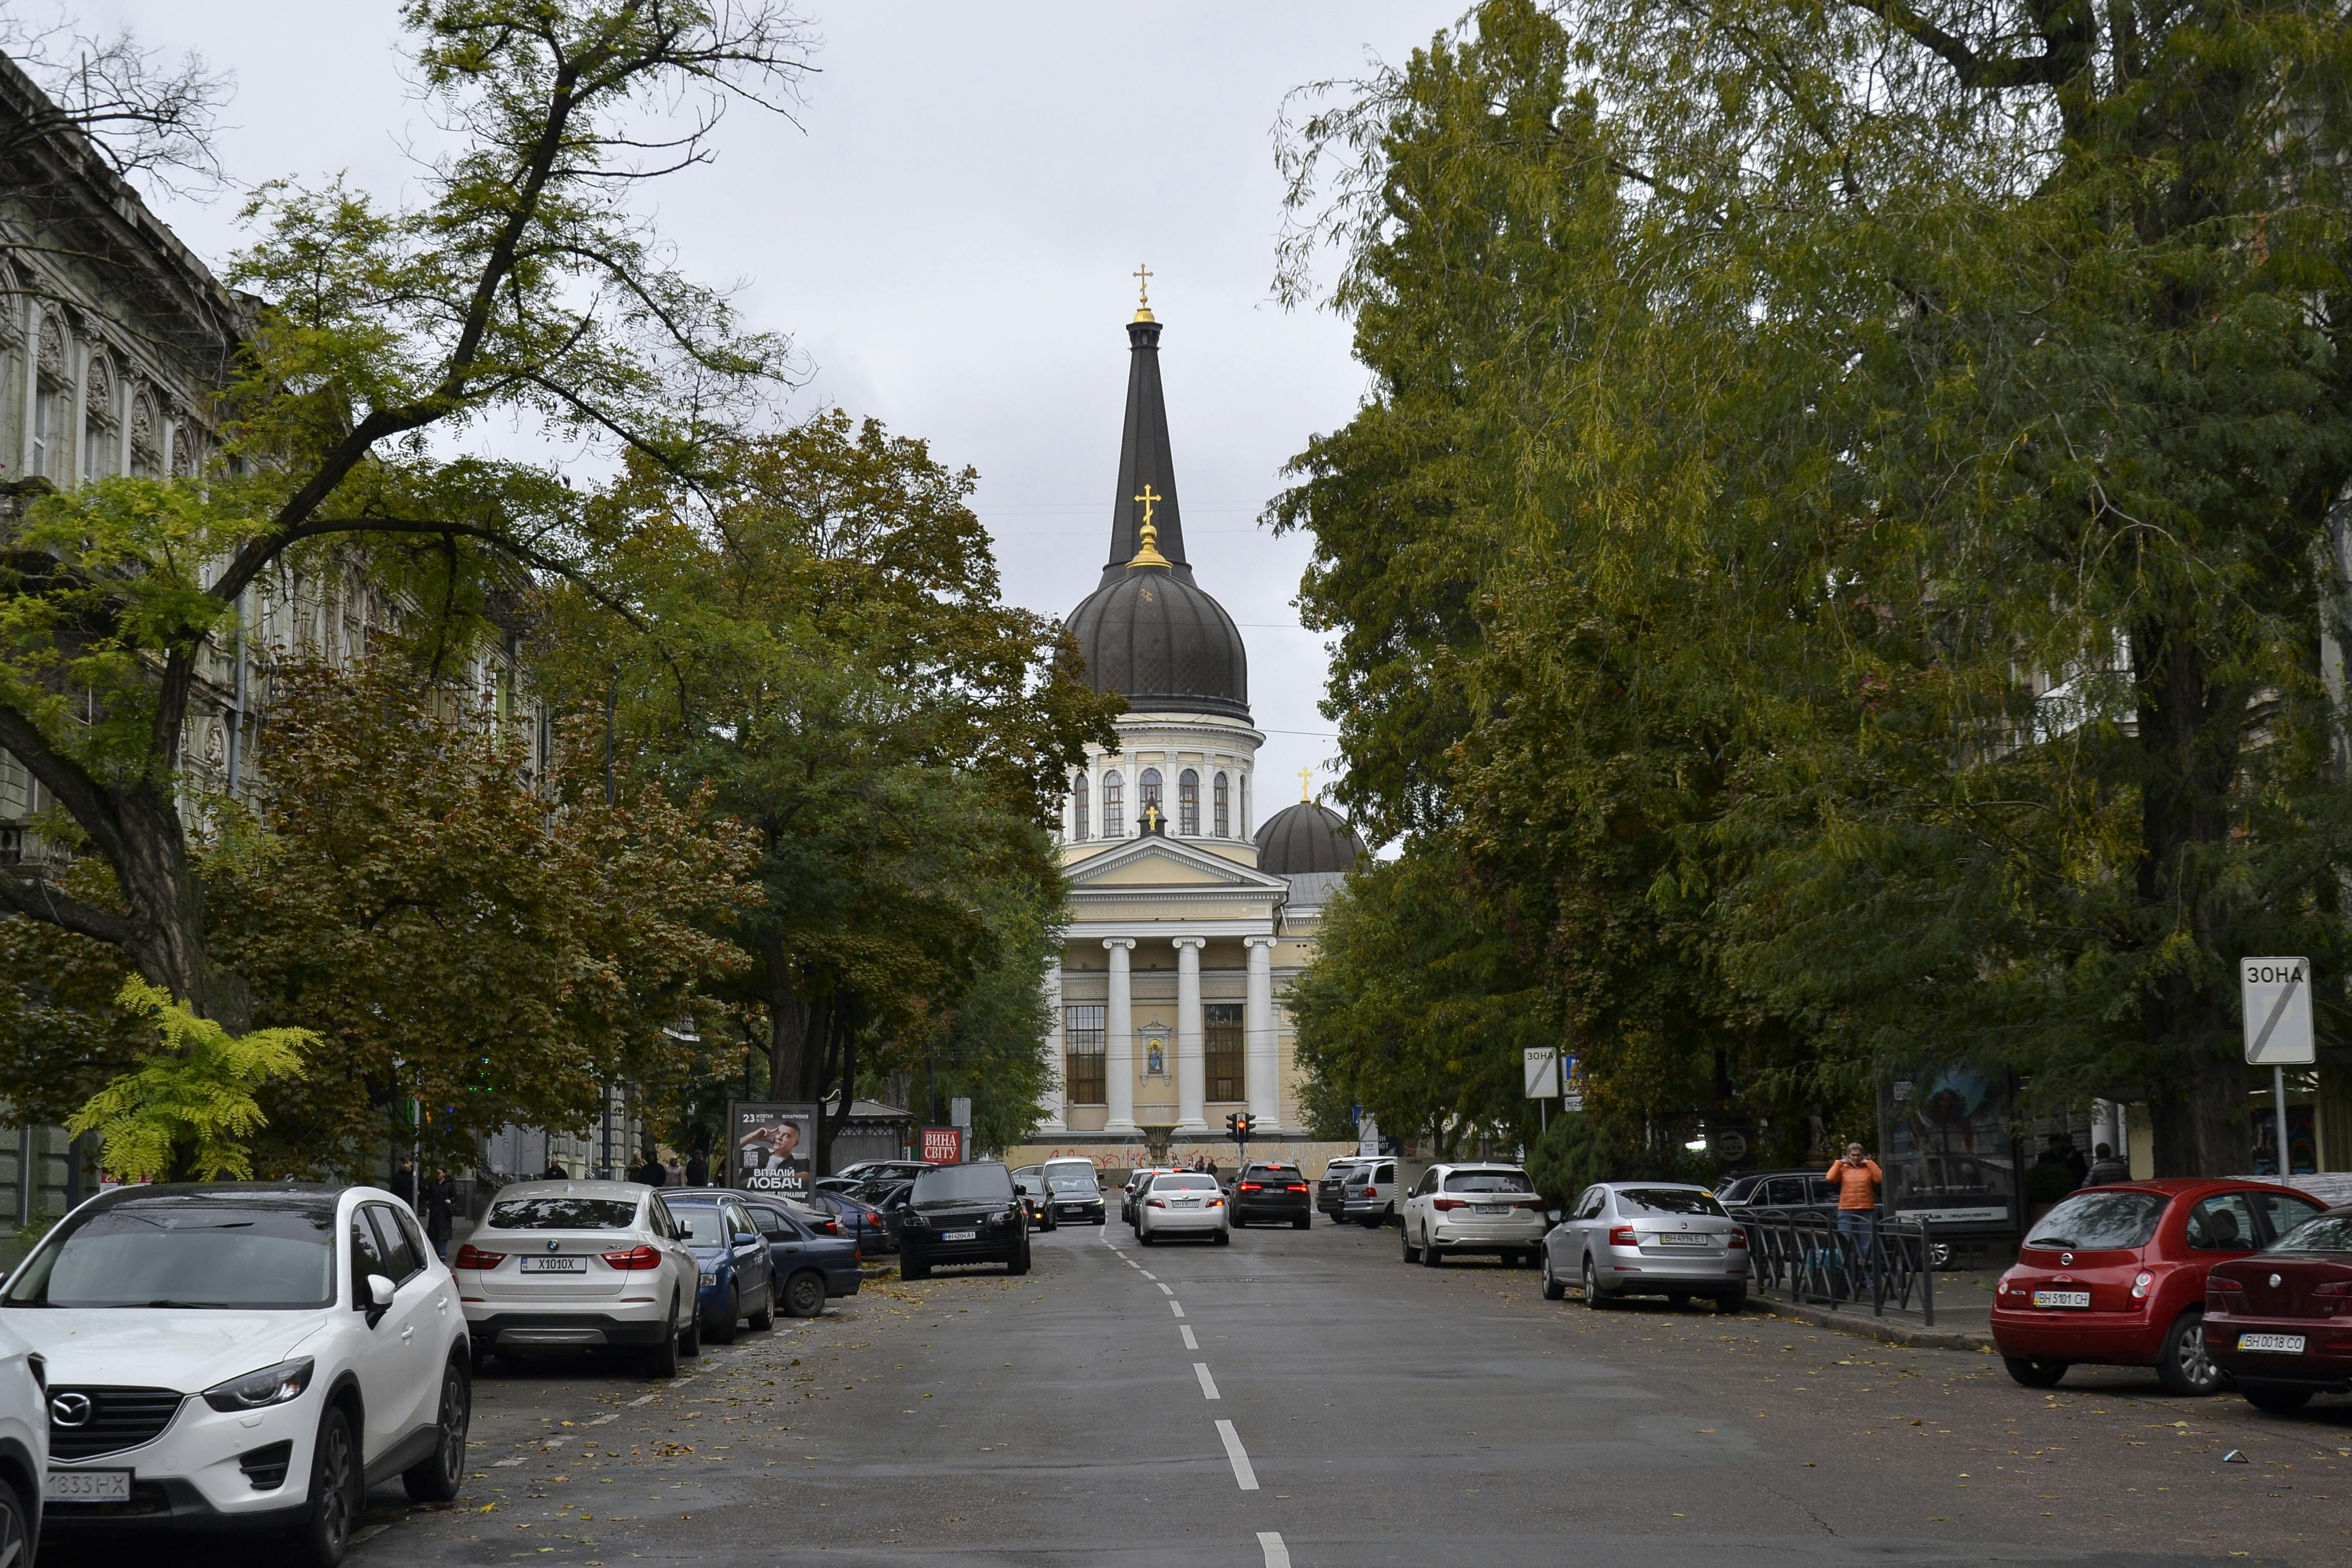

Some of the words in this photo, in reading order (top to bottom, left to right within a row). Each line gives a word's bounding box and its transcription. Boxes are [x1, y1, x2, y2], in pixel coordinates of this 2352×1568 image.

[2247, 967, 2304, 983] ЗОНА
[743, 1114, 755, 1122] 23
[925, 1134, 957, 1146] ВИНА
[924, 1146, 957, 1159] СВІТУ
[754, 1167, 795, 1177] ВІТАЛІЙ
[747, 1177, 802, 1189] ЛОБАЧ
[538, 1259, 574, 1269] X1010X
[2039, 1293, 2051, 1304] BH
[2245, 1336, 2260, 1347] BH
[2261, 1336, 2285, 1348] 0018
[2287, 1338, 2302, 1349] CO
